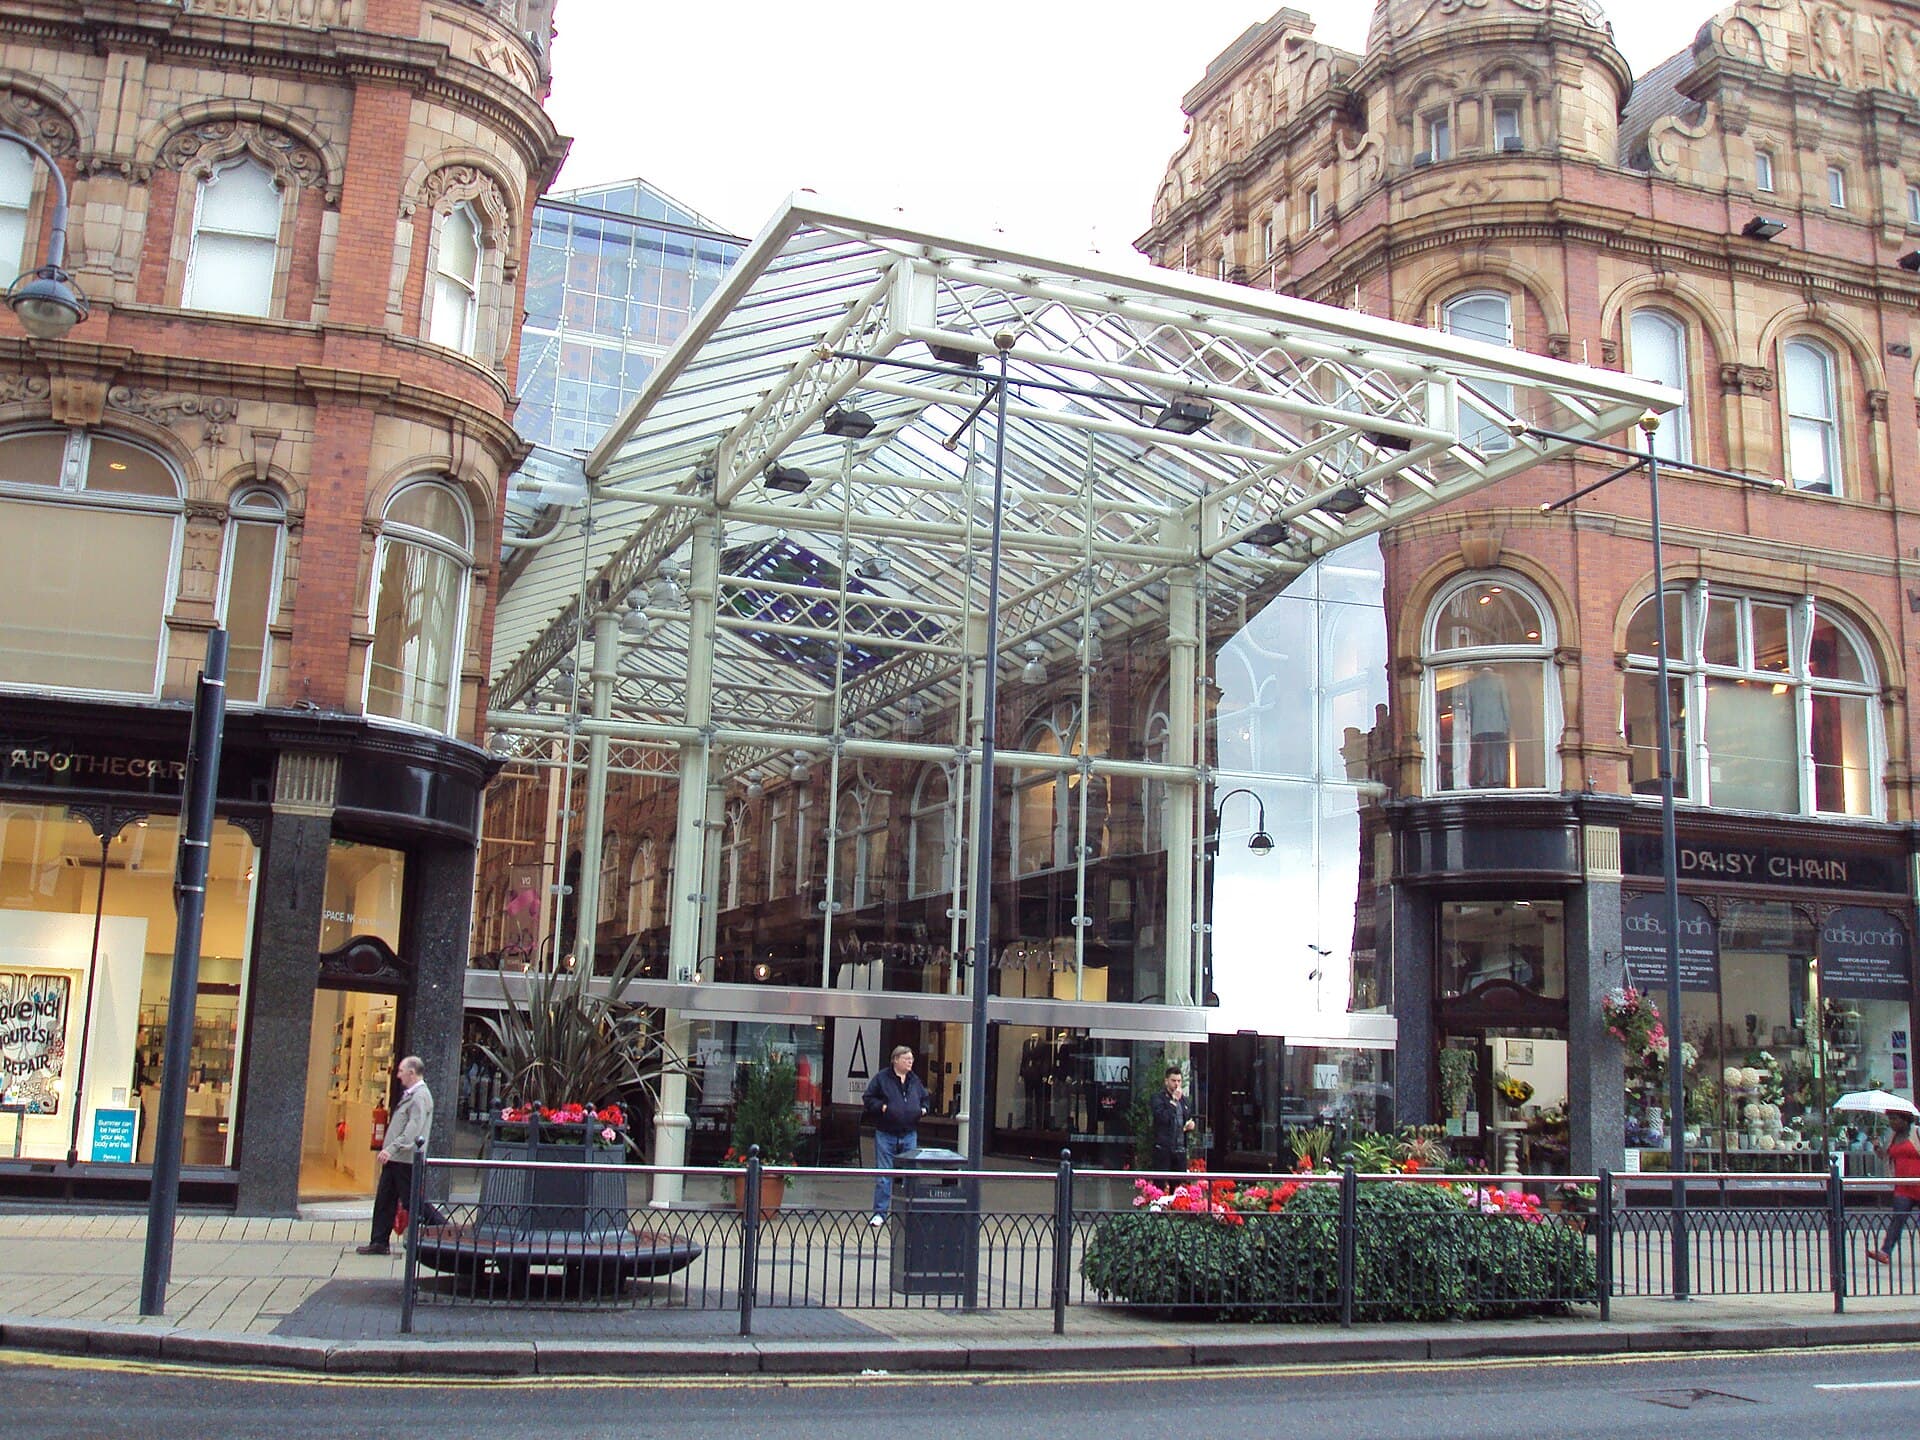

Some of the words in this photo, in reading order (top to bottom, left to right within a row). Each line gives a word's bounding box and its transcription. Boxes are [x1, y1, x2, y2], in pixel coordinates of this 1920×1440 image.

[11, 749, 186, 780] APOTHECAR
[1680, 849, 1757, 874] DAISY
[1767, 857, 1848, 881] CHAIN
[3, 1053, 51, 1076] REPAIR
[929, 1189, 951, 1198] Litter
